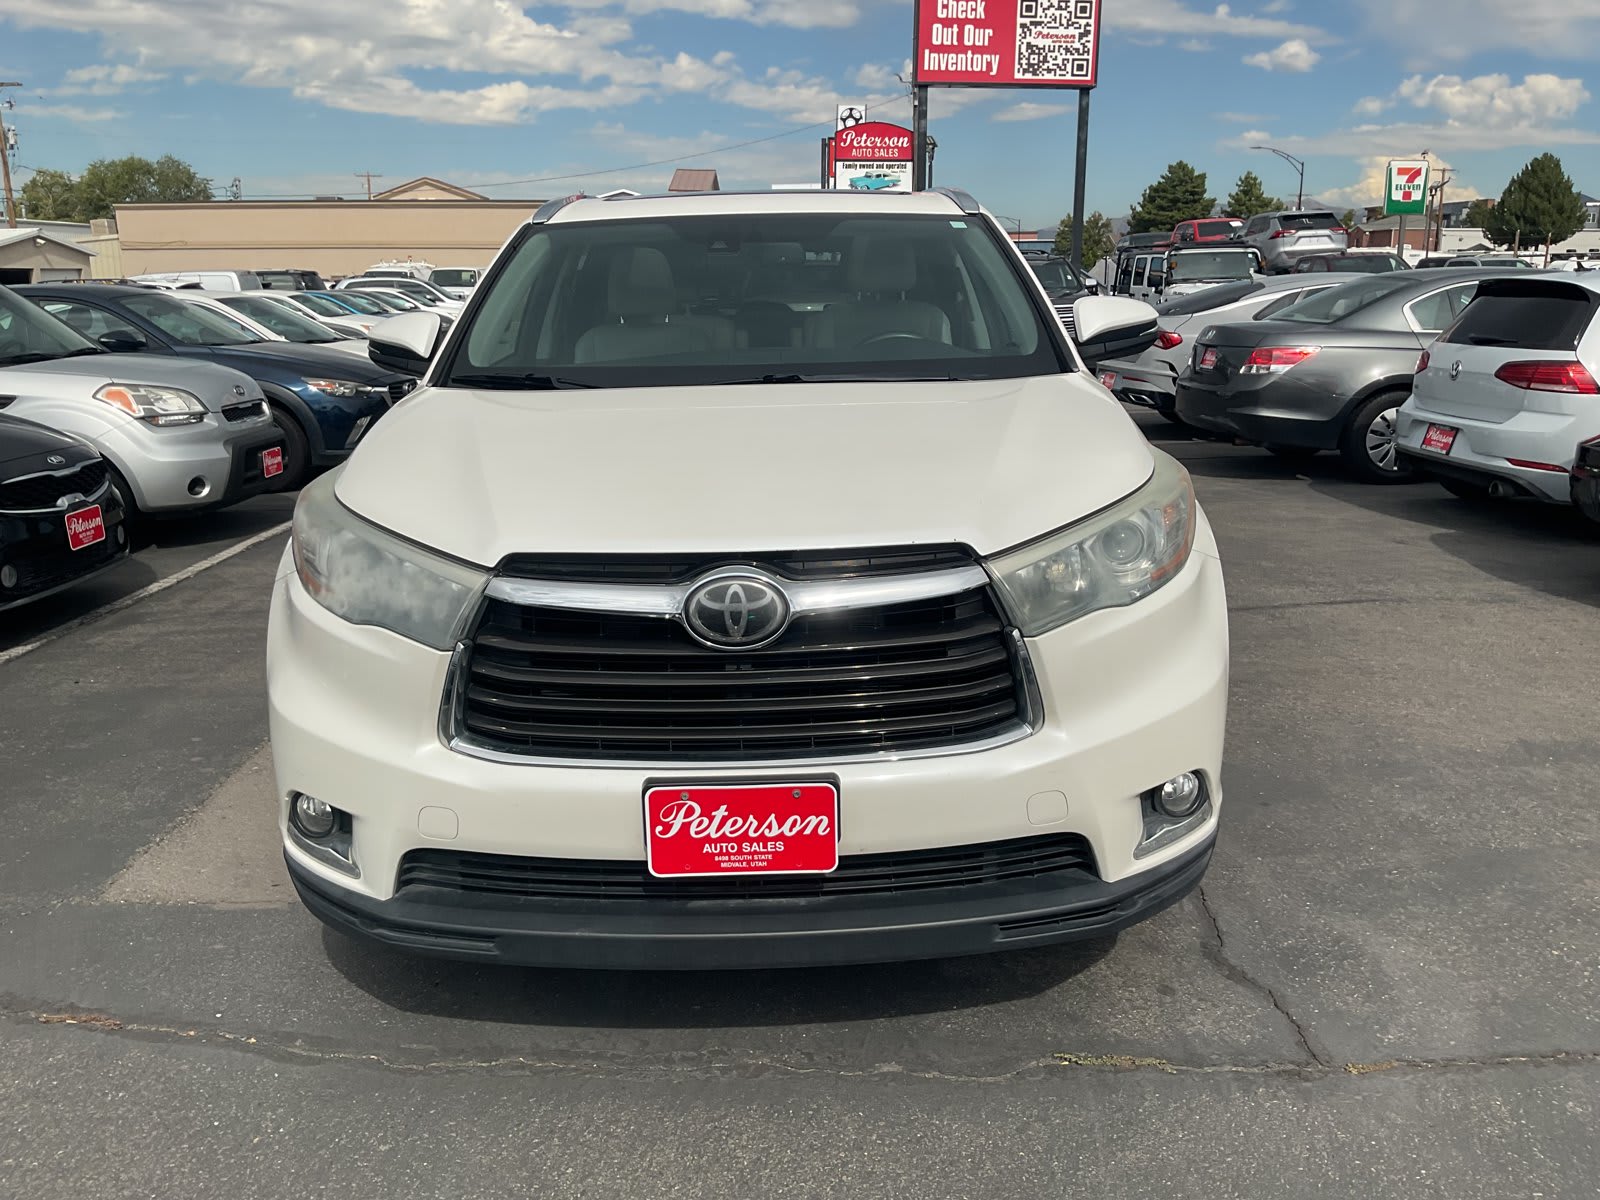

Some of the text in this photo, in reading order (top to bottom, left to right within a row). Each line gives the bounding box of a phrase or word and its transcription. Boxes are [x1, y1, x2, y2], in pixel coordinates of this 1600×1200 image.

[937, 0, 986, 19] Check
[931, 23, 993, 46] Out Our
[1033, 30, 1076, 39] Peterson
[924, 49, 1000, 76] Inventory
[840, 130, 910, 147] Peterson
[851, 148, 899, 157] AUTO SALES
[842, 162, 858, 170] Family
[885, 162, 907, 170] operated
[1397, 167, 1422, 200] 7
[69, 517, 102, 535] Peterson
[655, 800, 831, 839] Peterson
[702, 841, 785, 853] AUTO SALES
